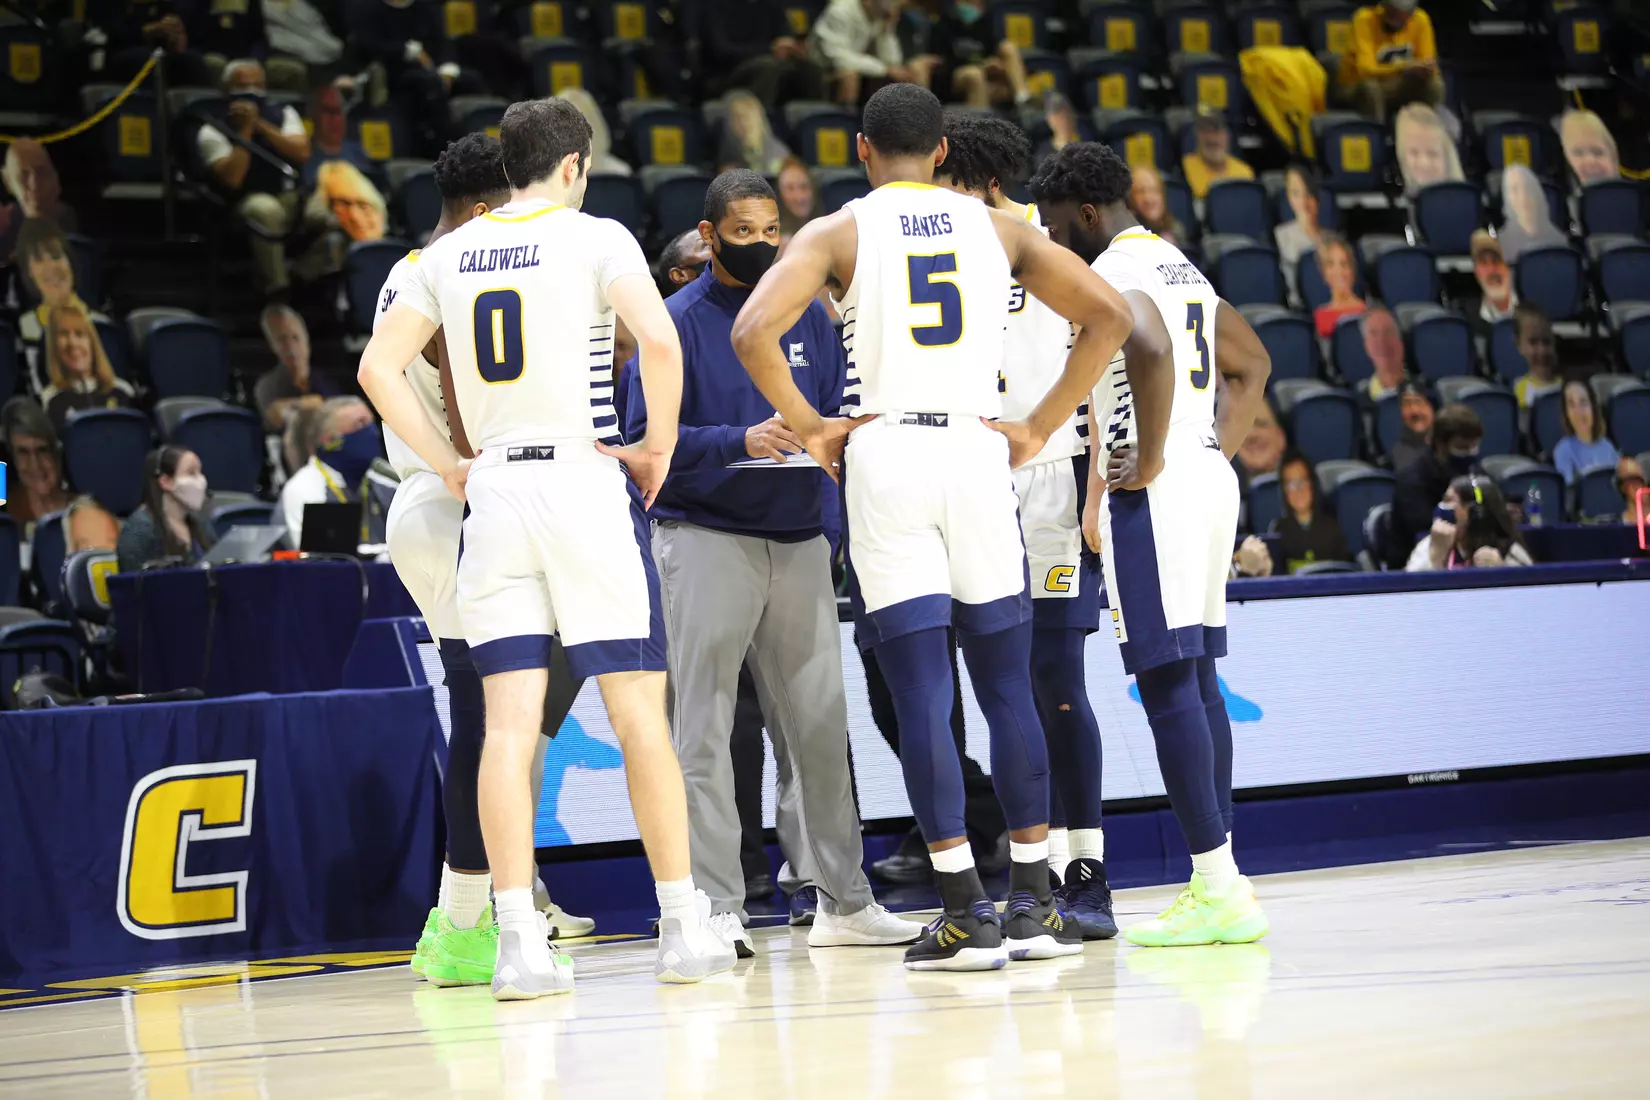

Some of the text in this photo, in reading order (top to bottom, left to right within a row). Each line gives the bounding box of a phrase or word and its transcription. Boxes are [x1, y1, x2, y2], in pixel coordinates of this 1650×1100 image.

[459, 244, 540, 274] CALDWELL
[899, 213, 953, 238] BANKS
[471, 287, 527, 385] 0
[906, 249, 964, 349] 5
[1185, 299, 1211, 392] 3
[1044, 564, 1076, 593] C
[116, 758, 257, 941] C
